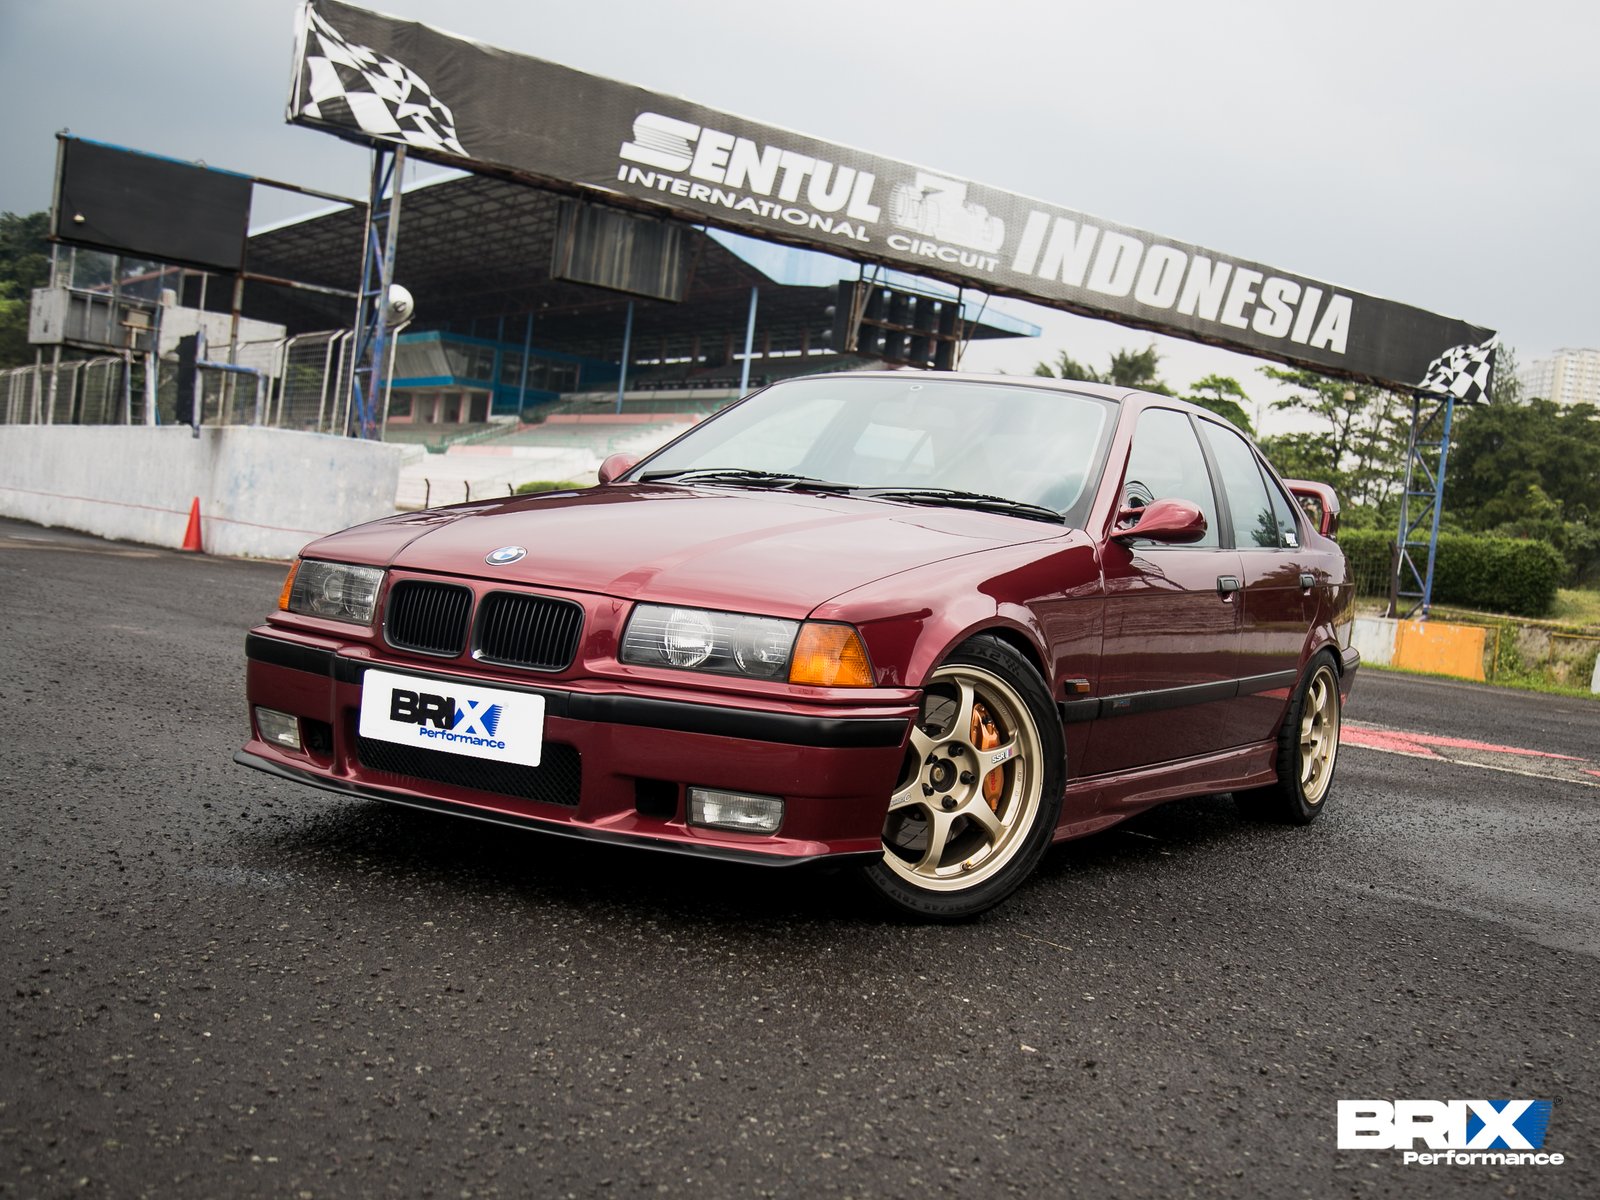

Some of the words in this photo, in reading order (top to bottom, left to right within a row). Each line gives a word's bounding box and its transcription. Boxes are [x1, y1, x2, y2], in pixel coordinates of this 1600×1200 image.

[619, 112, 881, 224] SENTUL
[617, 165, 870, 243] INTERNATIONAL
[887, 234, 1000, 273] CIRCUIT
[1011, 209, 1354, 355] INDONESIA
[390, 688, 503, 737] BRIX
[419, 727, 506, 750] Performance
[992, 751, 1007, 764] SSR
